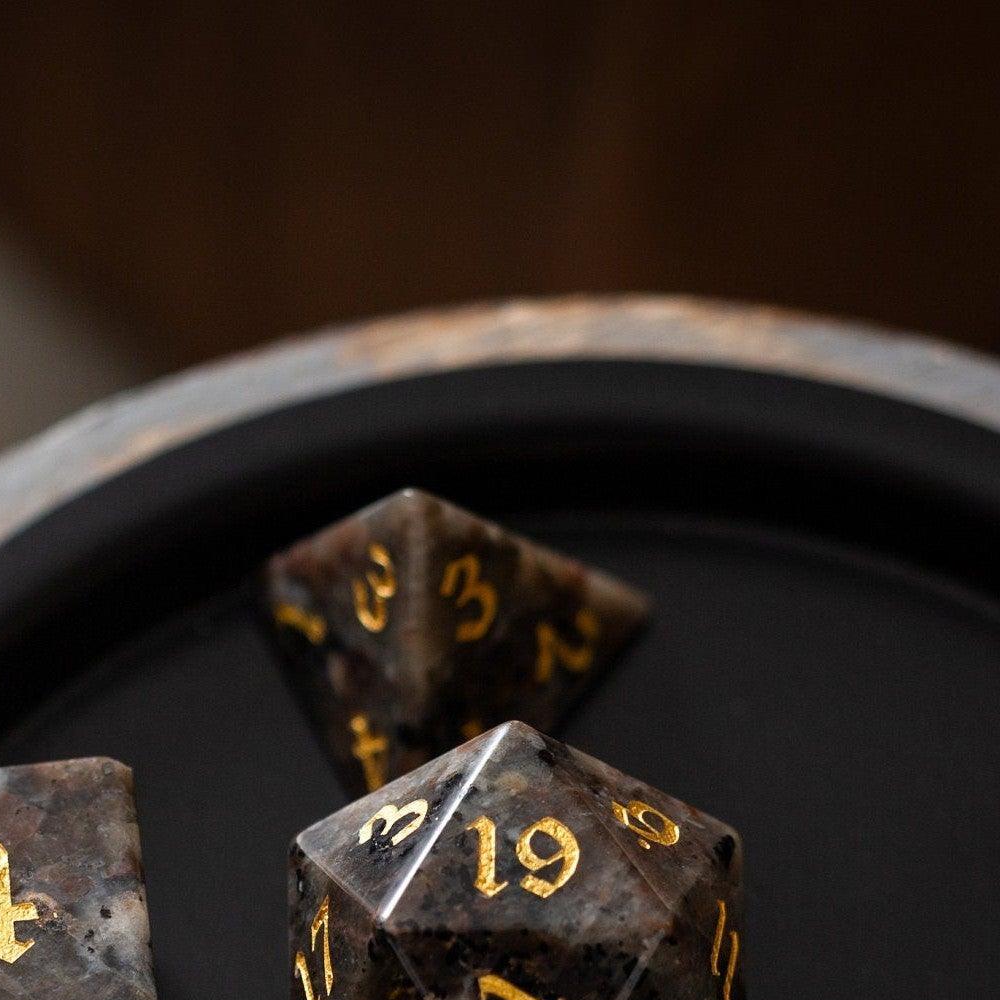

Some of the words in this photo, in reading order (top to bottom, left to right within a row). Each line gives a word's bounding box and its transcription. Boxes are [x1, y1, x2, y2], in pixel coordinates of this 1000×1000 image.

[439, 552, 499, 643] 3
[358, 798, 430, 846] 3
[465, 815, 582, 899] 19
